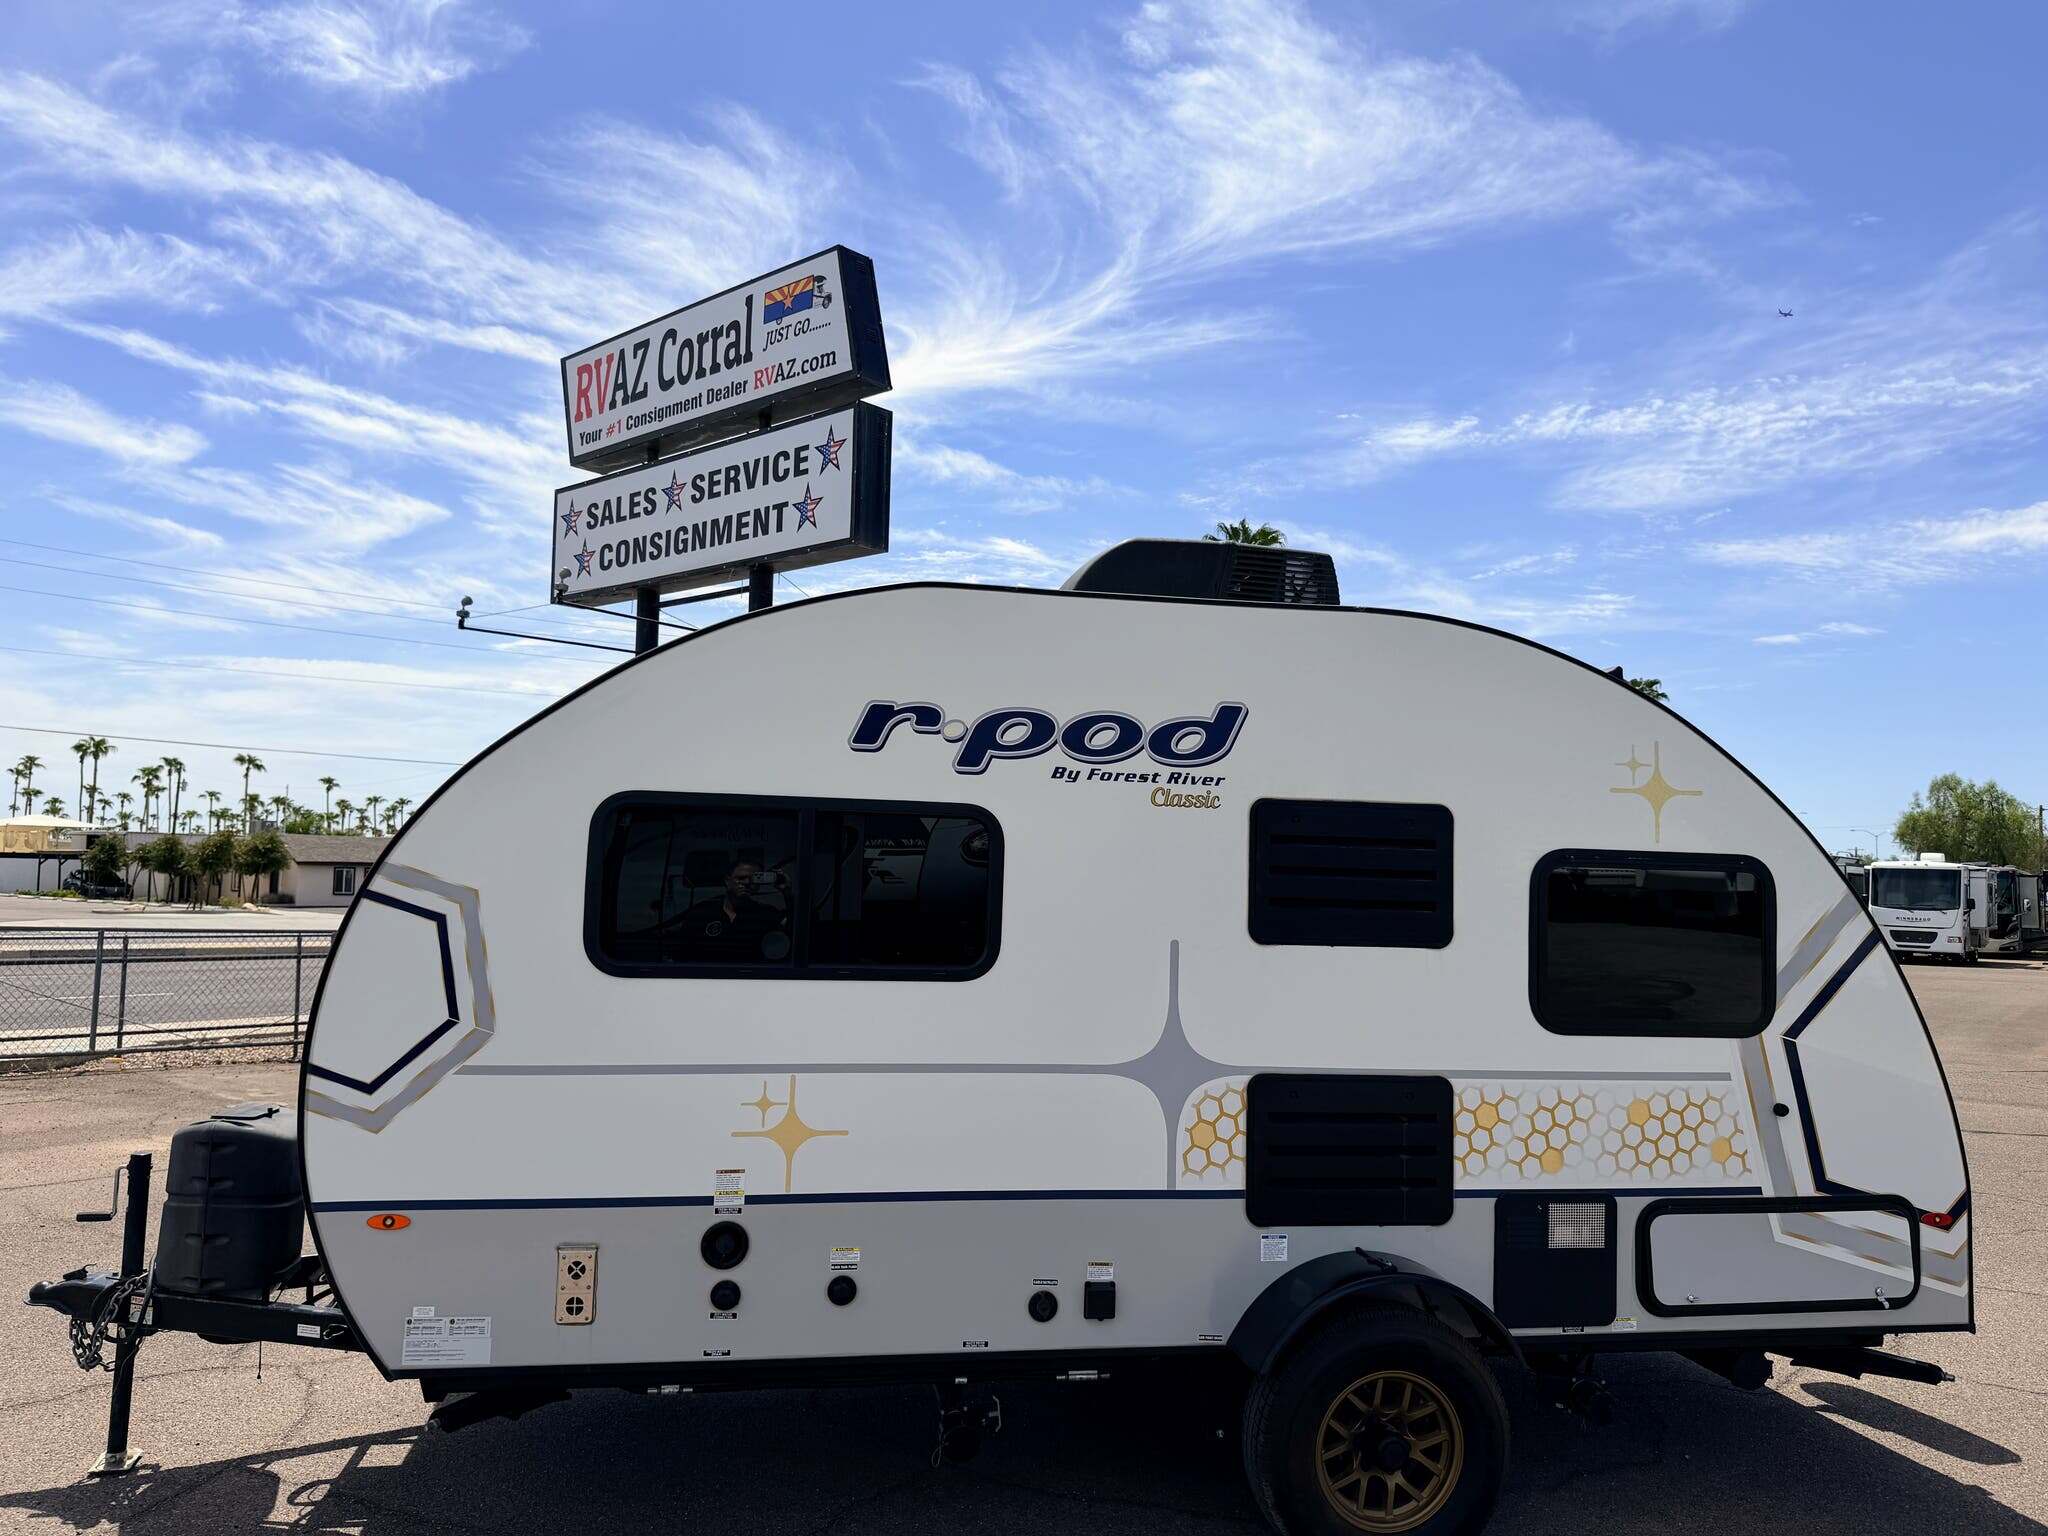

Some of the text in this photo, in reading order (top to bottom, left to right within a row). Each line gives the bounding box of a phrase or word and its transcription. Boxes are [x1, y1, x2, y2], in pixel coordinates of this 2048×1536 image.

[574, 294, 754, 423] RVAZ Corral
[762, 324, 792, 352] JUST
[579, 351, 837, 446] Your #1 Consignment Dealer RVAZ.com
[586, 444, 810, 531] SALES SERVICE
[599, 501, 790, 571] CONSIGNMENT
[1050, 766, 1226, 787] By Forest River
[1150, 786, 1222, 809] Classic
